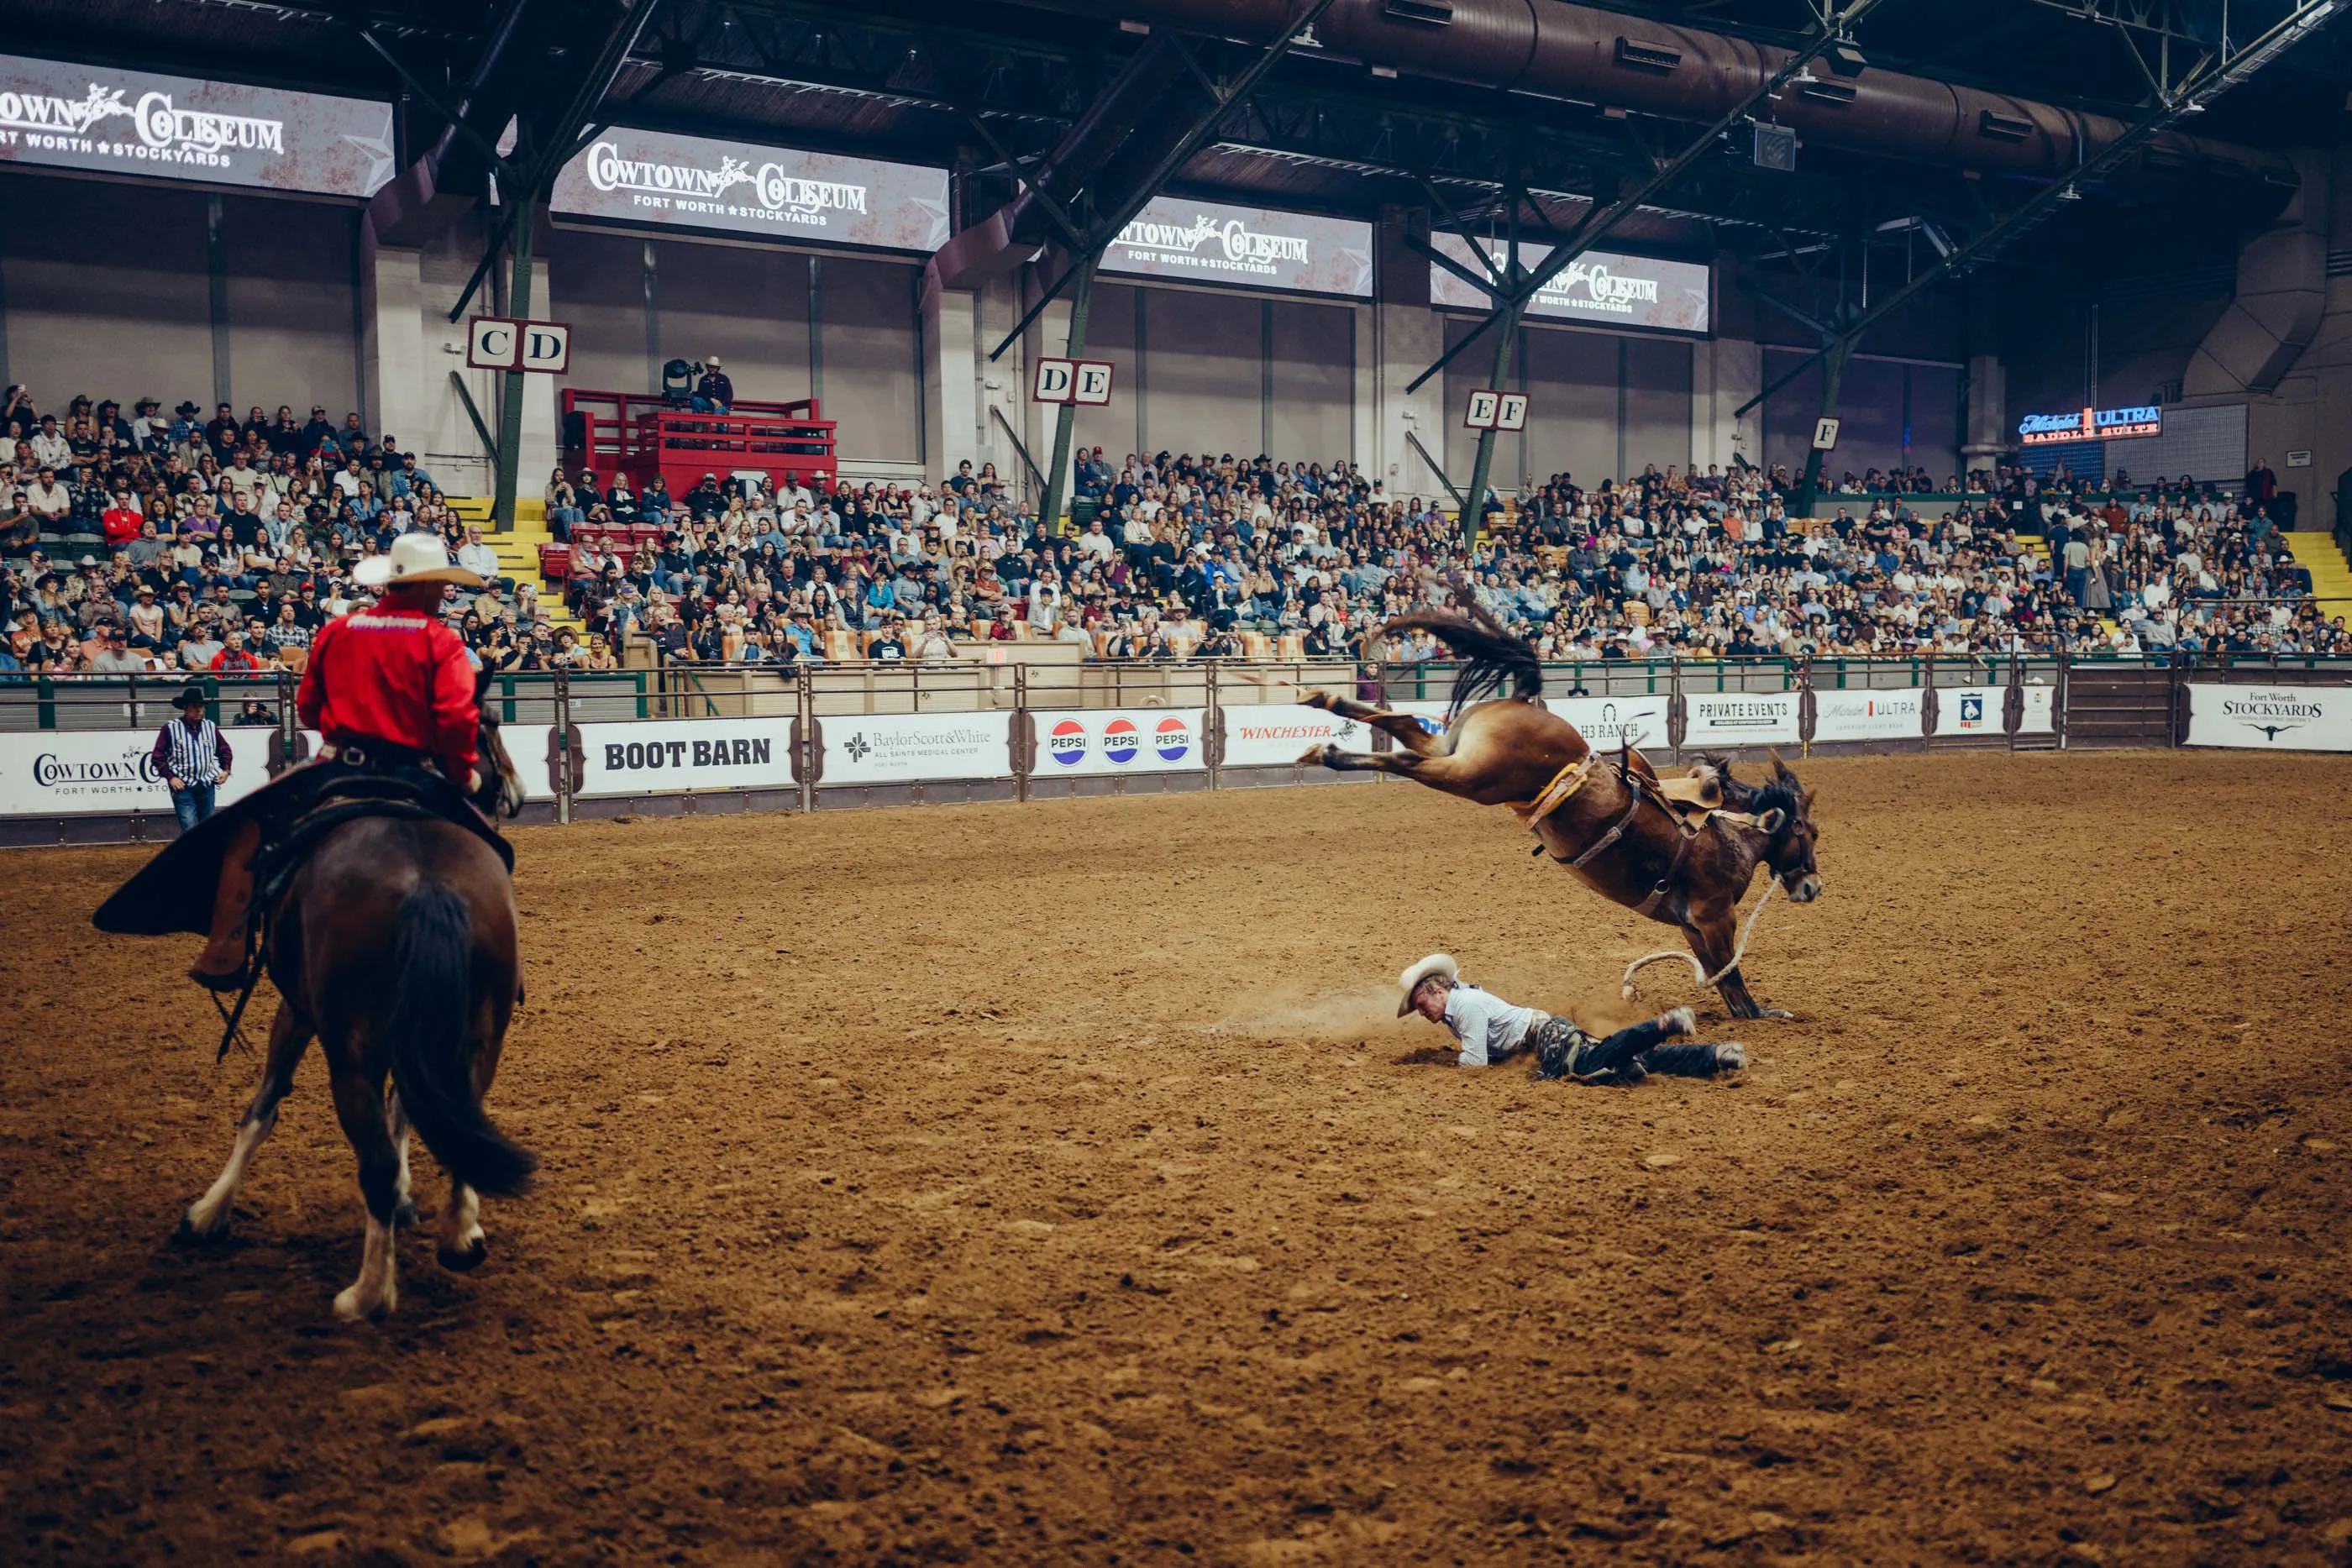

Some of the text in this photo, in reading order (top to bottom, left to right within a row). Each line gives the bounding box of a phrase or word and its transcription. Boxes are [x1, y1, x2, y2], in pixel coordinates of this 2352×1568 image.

[134, 91, 284, 155] COLISEUM
[26, 133, 92, 153] WORTH
[113, 144, 231, 168] STOCKYARDS
[588, 142, 867, 214] COWTOWN COLISEUM
[633, 195, 827, 227] FORT WORTH STOCKYARDS
[1110, 220, 1308, 264] WTOWN COLISEUM
[1128, 250, 1278, 275] FORT WORTH STOCKYARDS
[1588, 265, 1658, 304] COLISEUM
[1539, 296, 1571, 307] WORTH
[1578, 300, 1633, 313] STOCKYARDS
[481, 330, 561, 359] C D
[1042, 369, 1105, 393] D E
[1473, 399, 1522, 420] E F
[2096, 406, 2159, 427] ULTRA
[1819, 424, 1835, 442] F
[2023, 423, 2157, 443] SADDLE SUITE
[2250, 692, 2297, 702] Fort Worth
[1700, 703, 1788, 717] PRIVATE EVENTS
[1877, 702, 1915, 716] ULTRA
[2223, 700, 2322, 718] STOCKYARDS
[1156, 735, 1189, 745] PEPSI
[1240, 725, 1331, 739] WINCHESTER
[1581, 723, 1638, 738] H3 RANCH
[1051, 737, 1086, 747] PEPSI
[1104, 736, 1138, 746] PEPSI
[605, 738, 770, 770] BOOT BARN
[34, 753, 136, 787] COWTOWN
[55, 785, 133, 795] FORT WORTH
